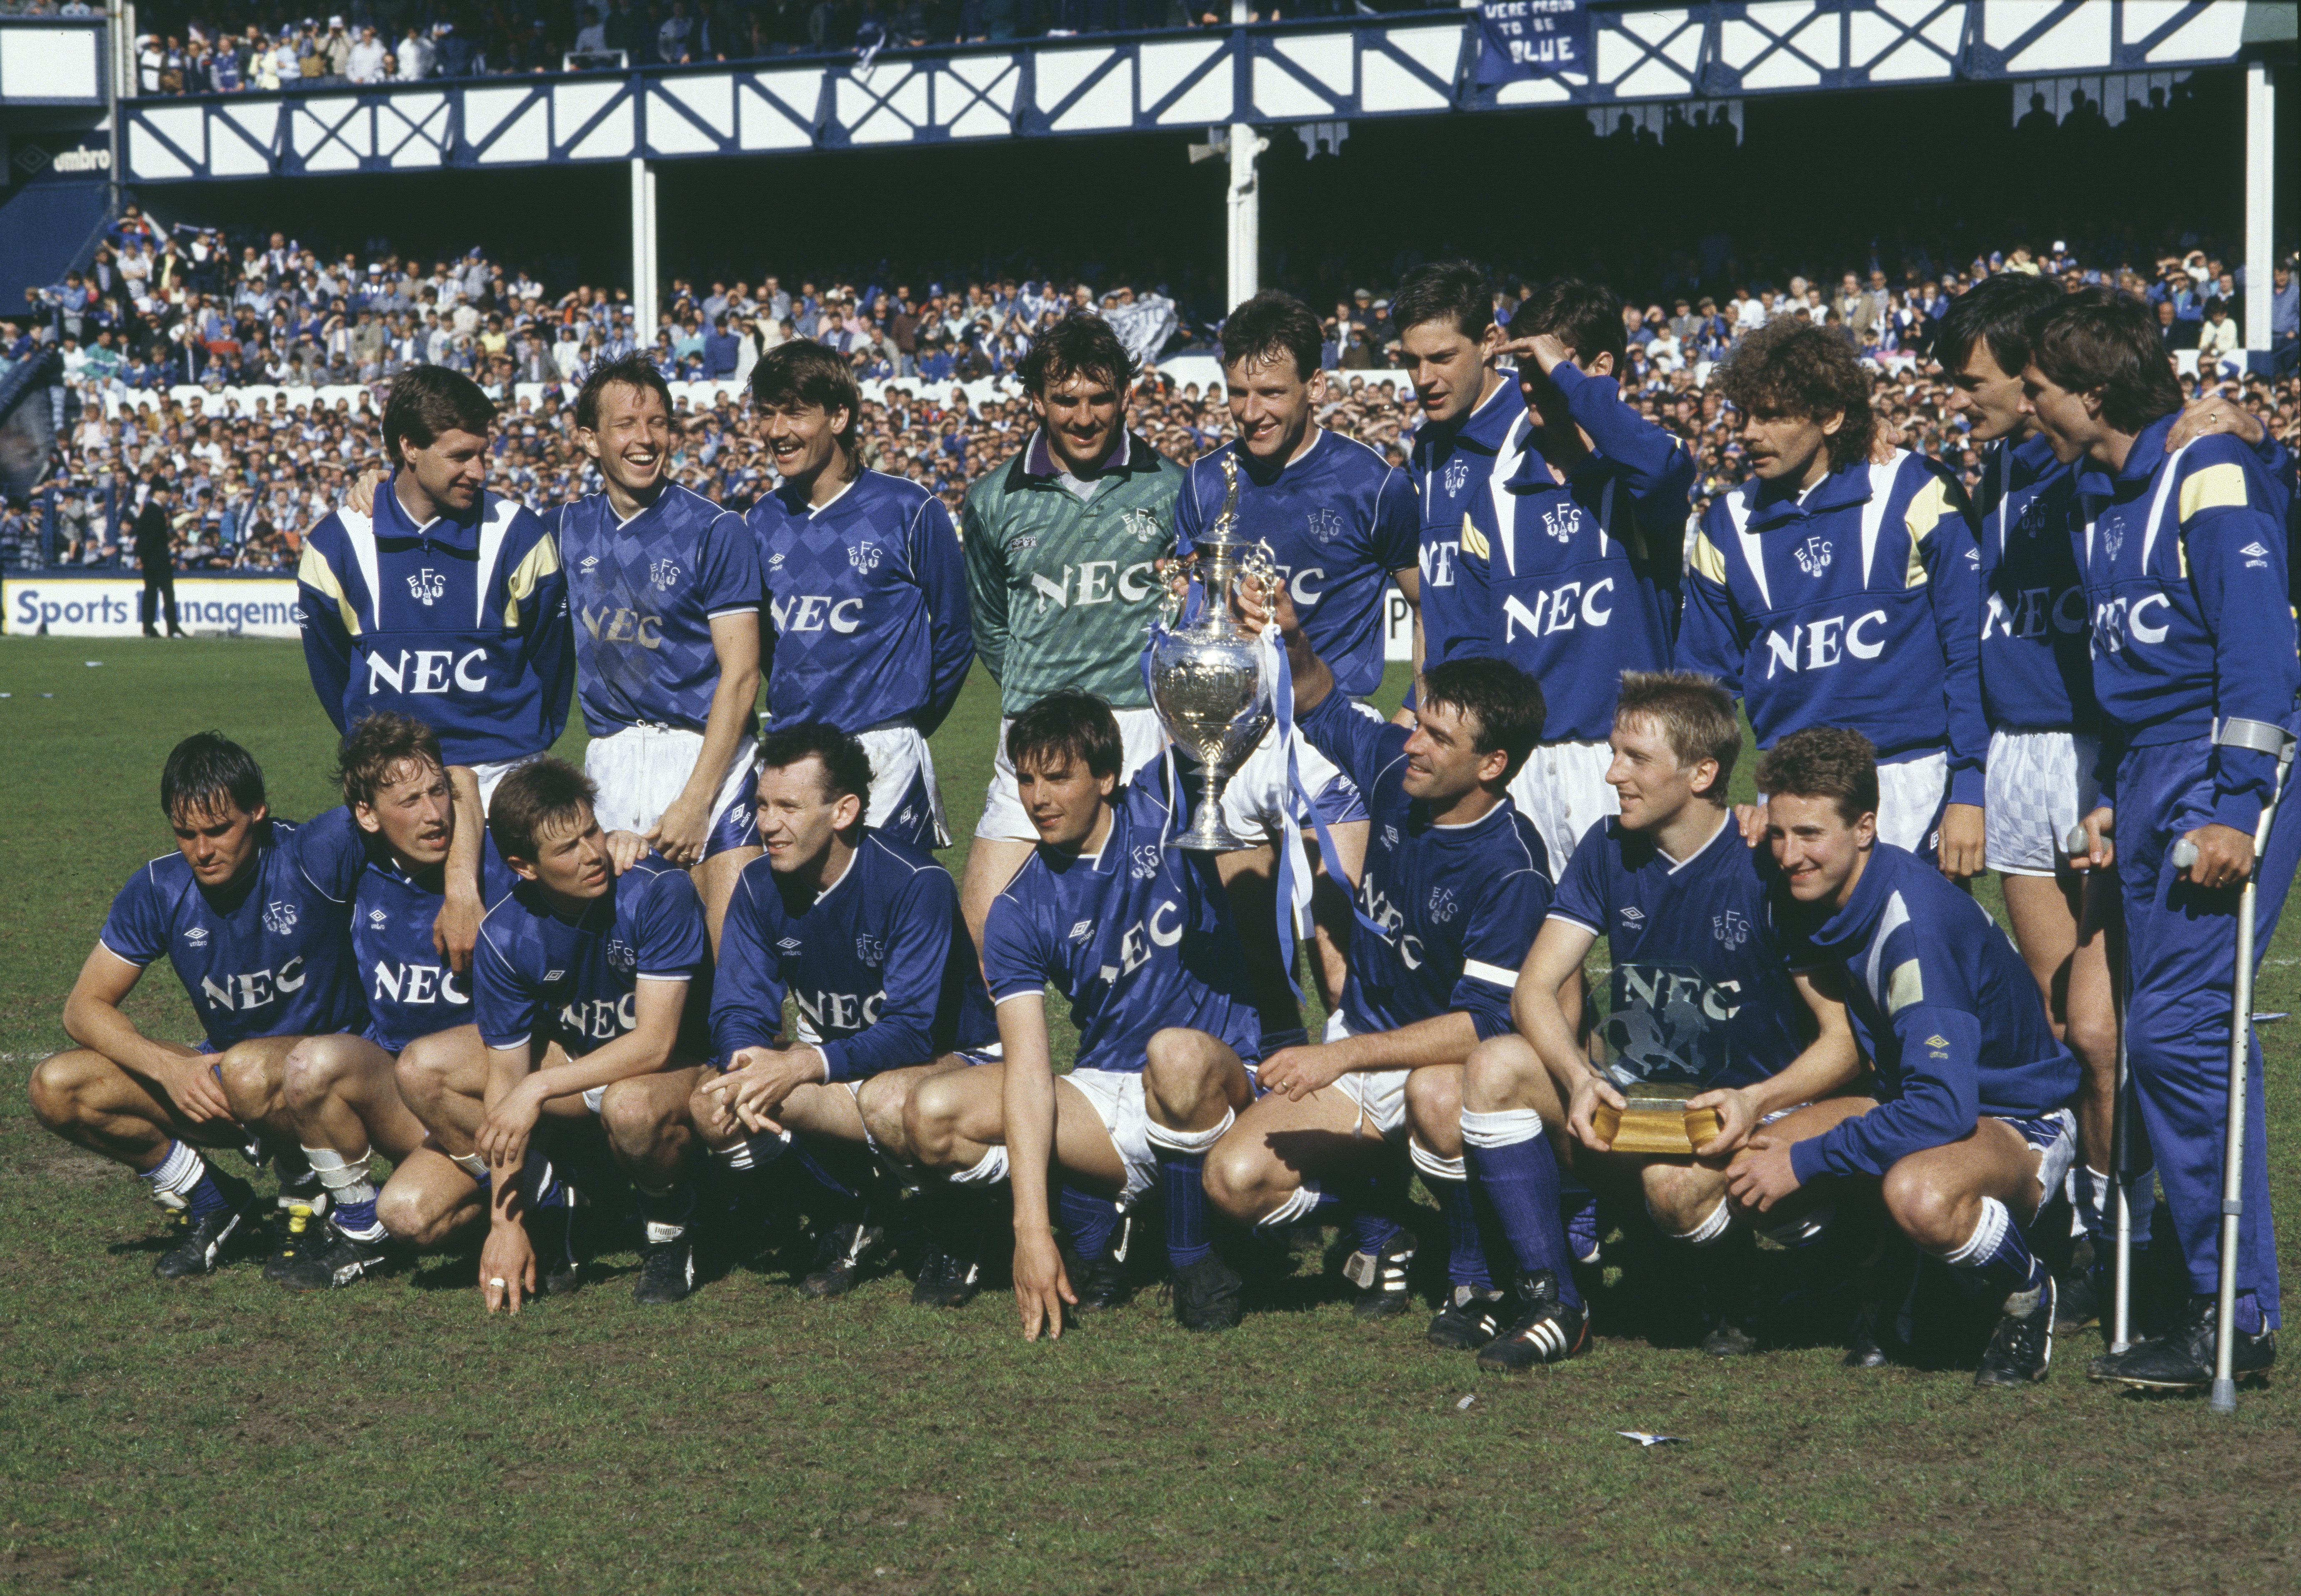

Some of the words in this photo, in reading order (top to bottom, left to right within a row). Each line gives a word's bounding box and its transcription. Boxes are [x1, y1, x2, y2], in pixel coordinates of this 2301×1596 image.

[1498, 21, 1523, 36] TO
[1509, 36, 1574, 64] BLUE
[53, 145, 110, 173] umbro
[1031, 560, 1153, 614] NEC
[1418, 541, 1459, 586] NE
[17, 589, 128, 627] Sports
[1503, 577, 1614, 644] NEC
[1981, 585, 2085, 640] NEC
[1766, 609, 1887, 679] NEC
[366, 648, 488, 695] NEC
[201, 955, 306, 1011] NEC
